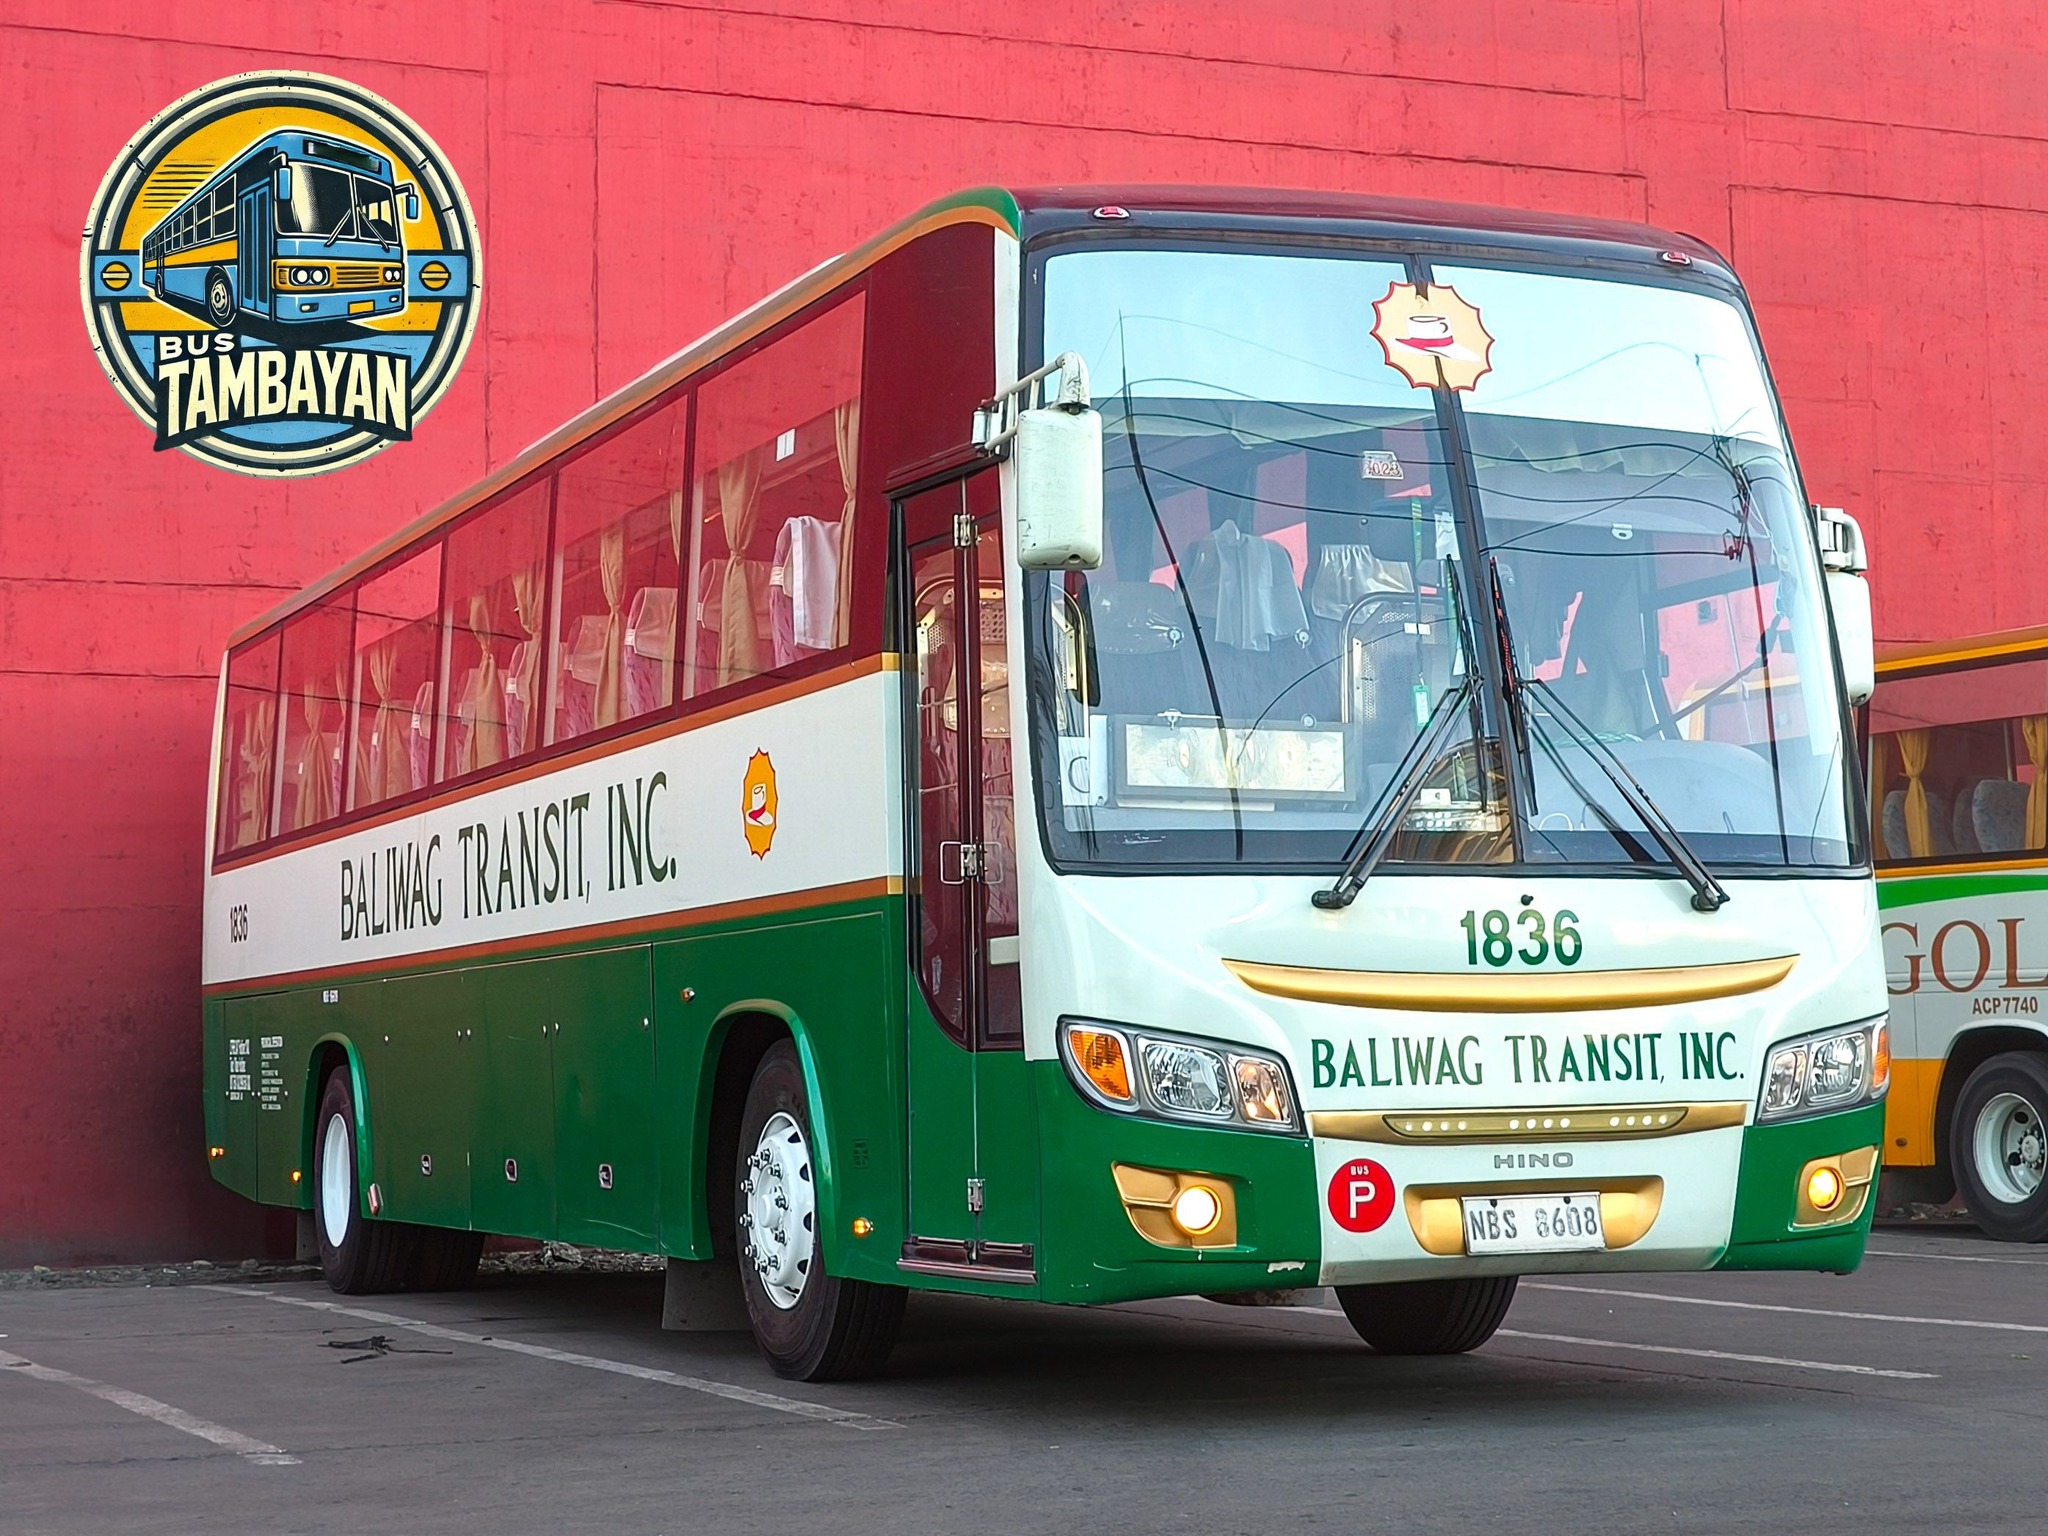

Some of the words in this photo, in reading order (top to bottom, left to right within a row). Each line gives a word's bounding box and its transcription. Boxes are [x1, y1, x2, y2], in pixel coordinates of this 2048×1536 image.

[340, 834, 442, 941] BALIWAG
[457, 792, 591, 919] TRANSIT,
[606, 770, 677, 892] INC.
[229, 903, 249, 944] 1836
[1460, 909, 1583, 967] 1836
[1311, 1035, 1483, 1089] BALIWAG
[1504, 1033, 1665, 1085] TRANSIT,
[1678, 1031, 1746, 1081] INC.
[1350, 1165, 1370, 1176] BUS
[1493, 1152, 1574, 1169] HINO
[1349, 1181, 1376, 1219] P
[1469, 1208, 1518, 1241] NBS
[1535, 1206, 1598, 1238] 8608
